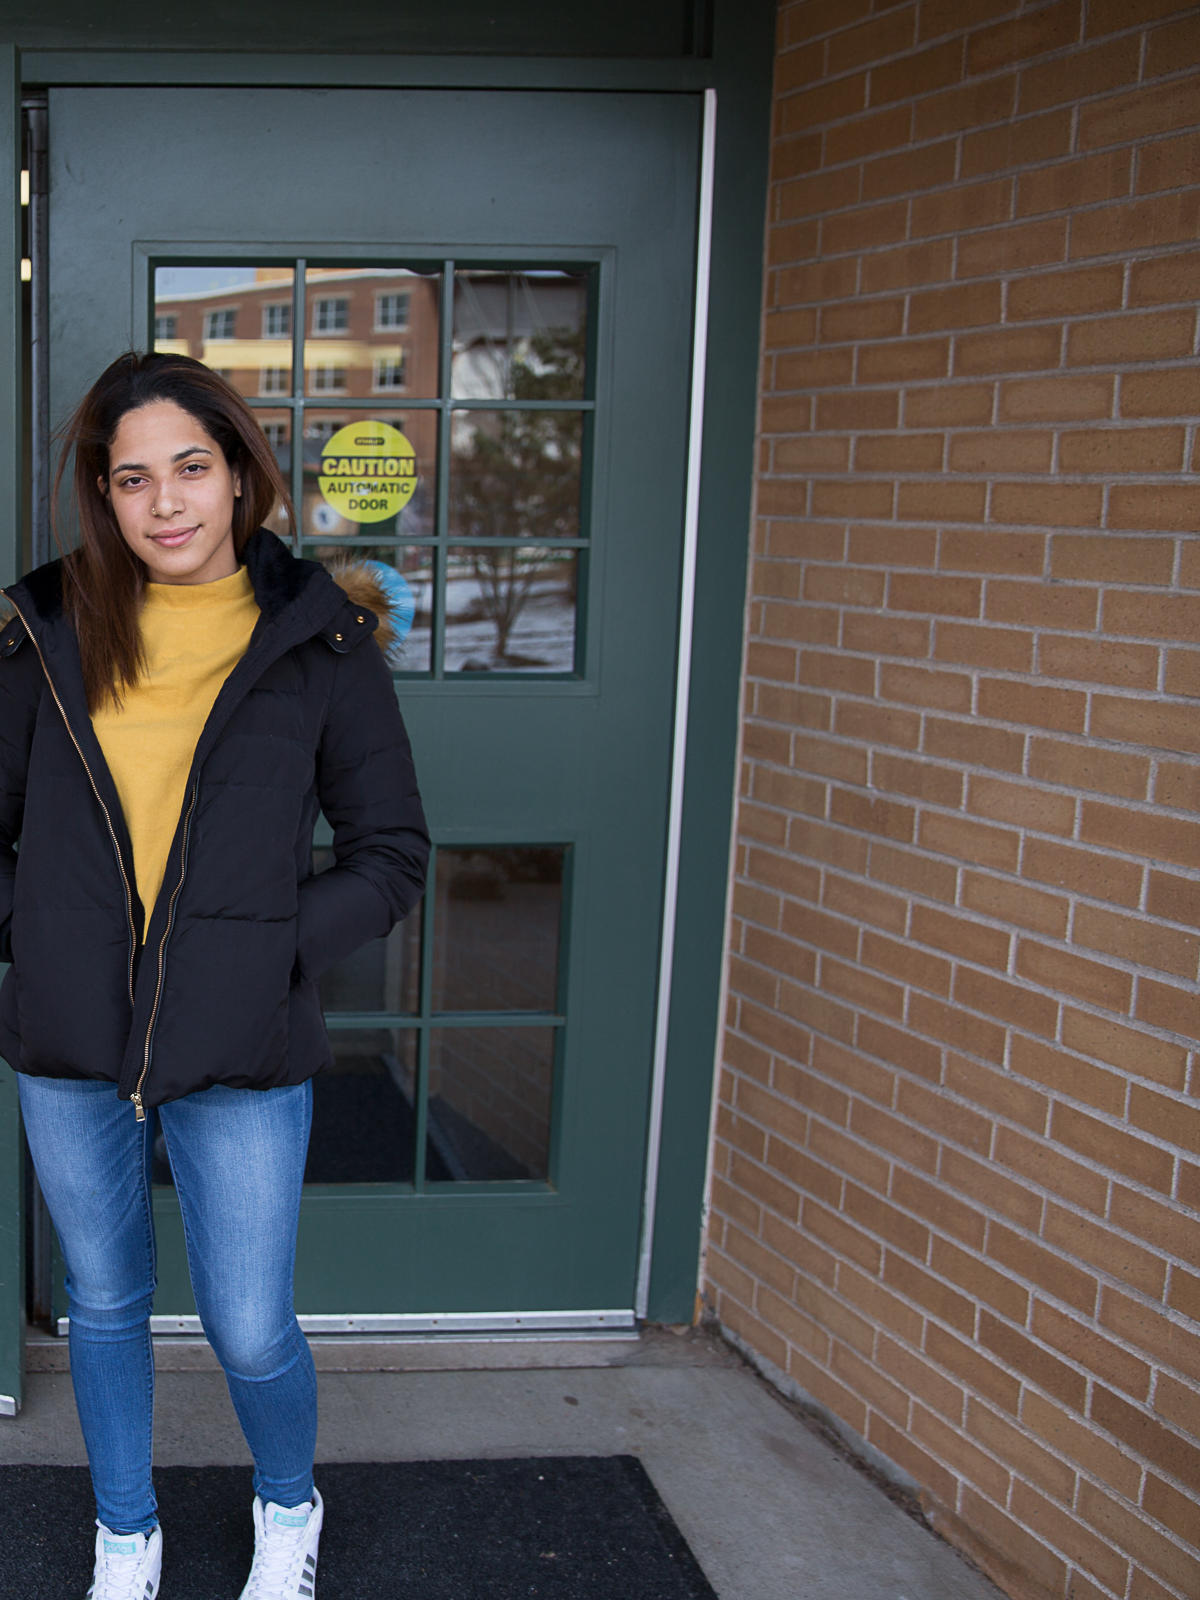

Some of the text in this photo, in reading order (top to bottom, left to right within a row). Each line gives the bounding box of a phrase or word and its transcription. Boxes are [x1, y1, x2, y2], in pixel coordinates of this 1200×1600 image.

[321, 457, 415, 476] CAUTION
[327, 482, 411, 494] AUTOMATIC
[348, 499, 389, 510] DOOR
